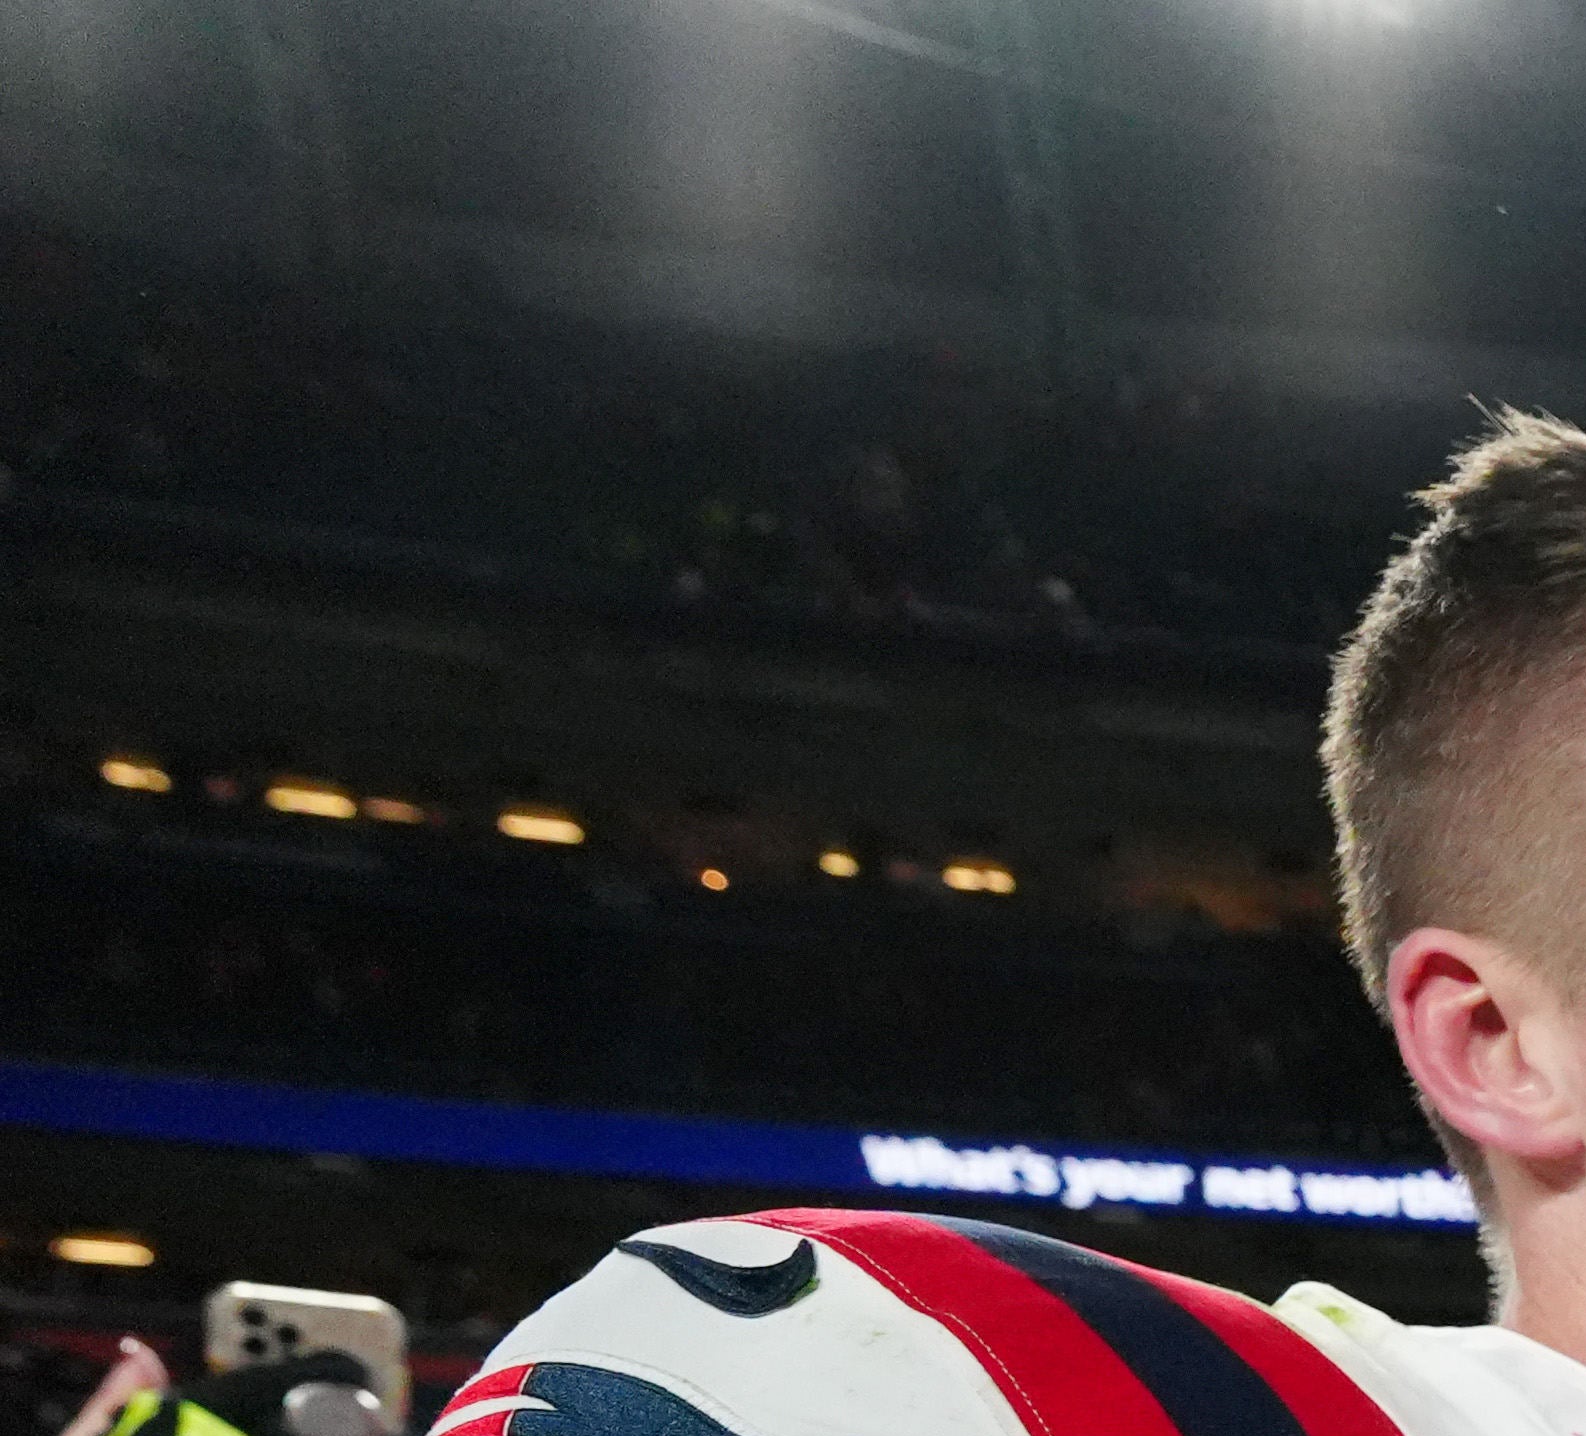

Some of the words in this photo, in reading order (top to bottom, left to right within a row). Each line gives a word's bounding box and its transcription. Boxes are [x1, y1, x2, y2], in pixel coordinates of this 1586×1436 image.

[861, 1134, 1060, 1197] What's
[1060, 1156, 1194, 1210] your
[1203, 1165, 1298, 1212] net
